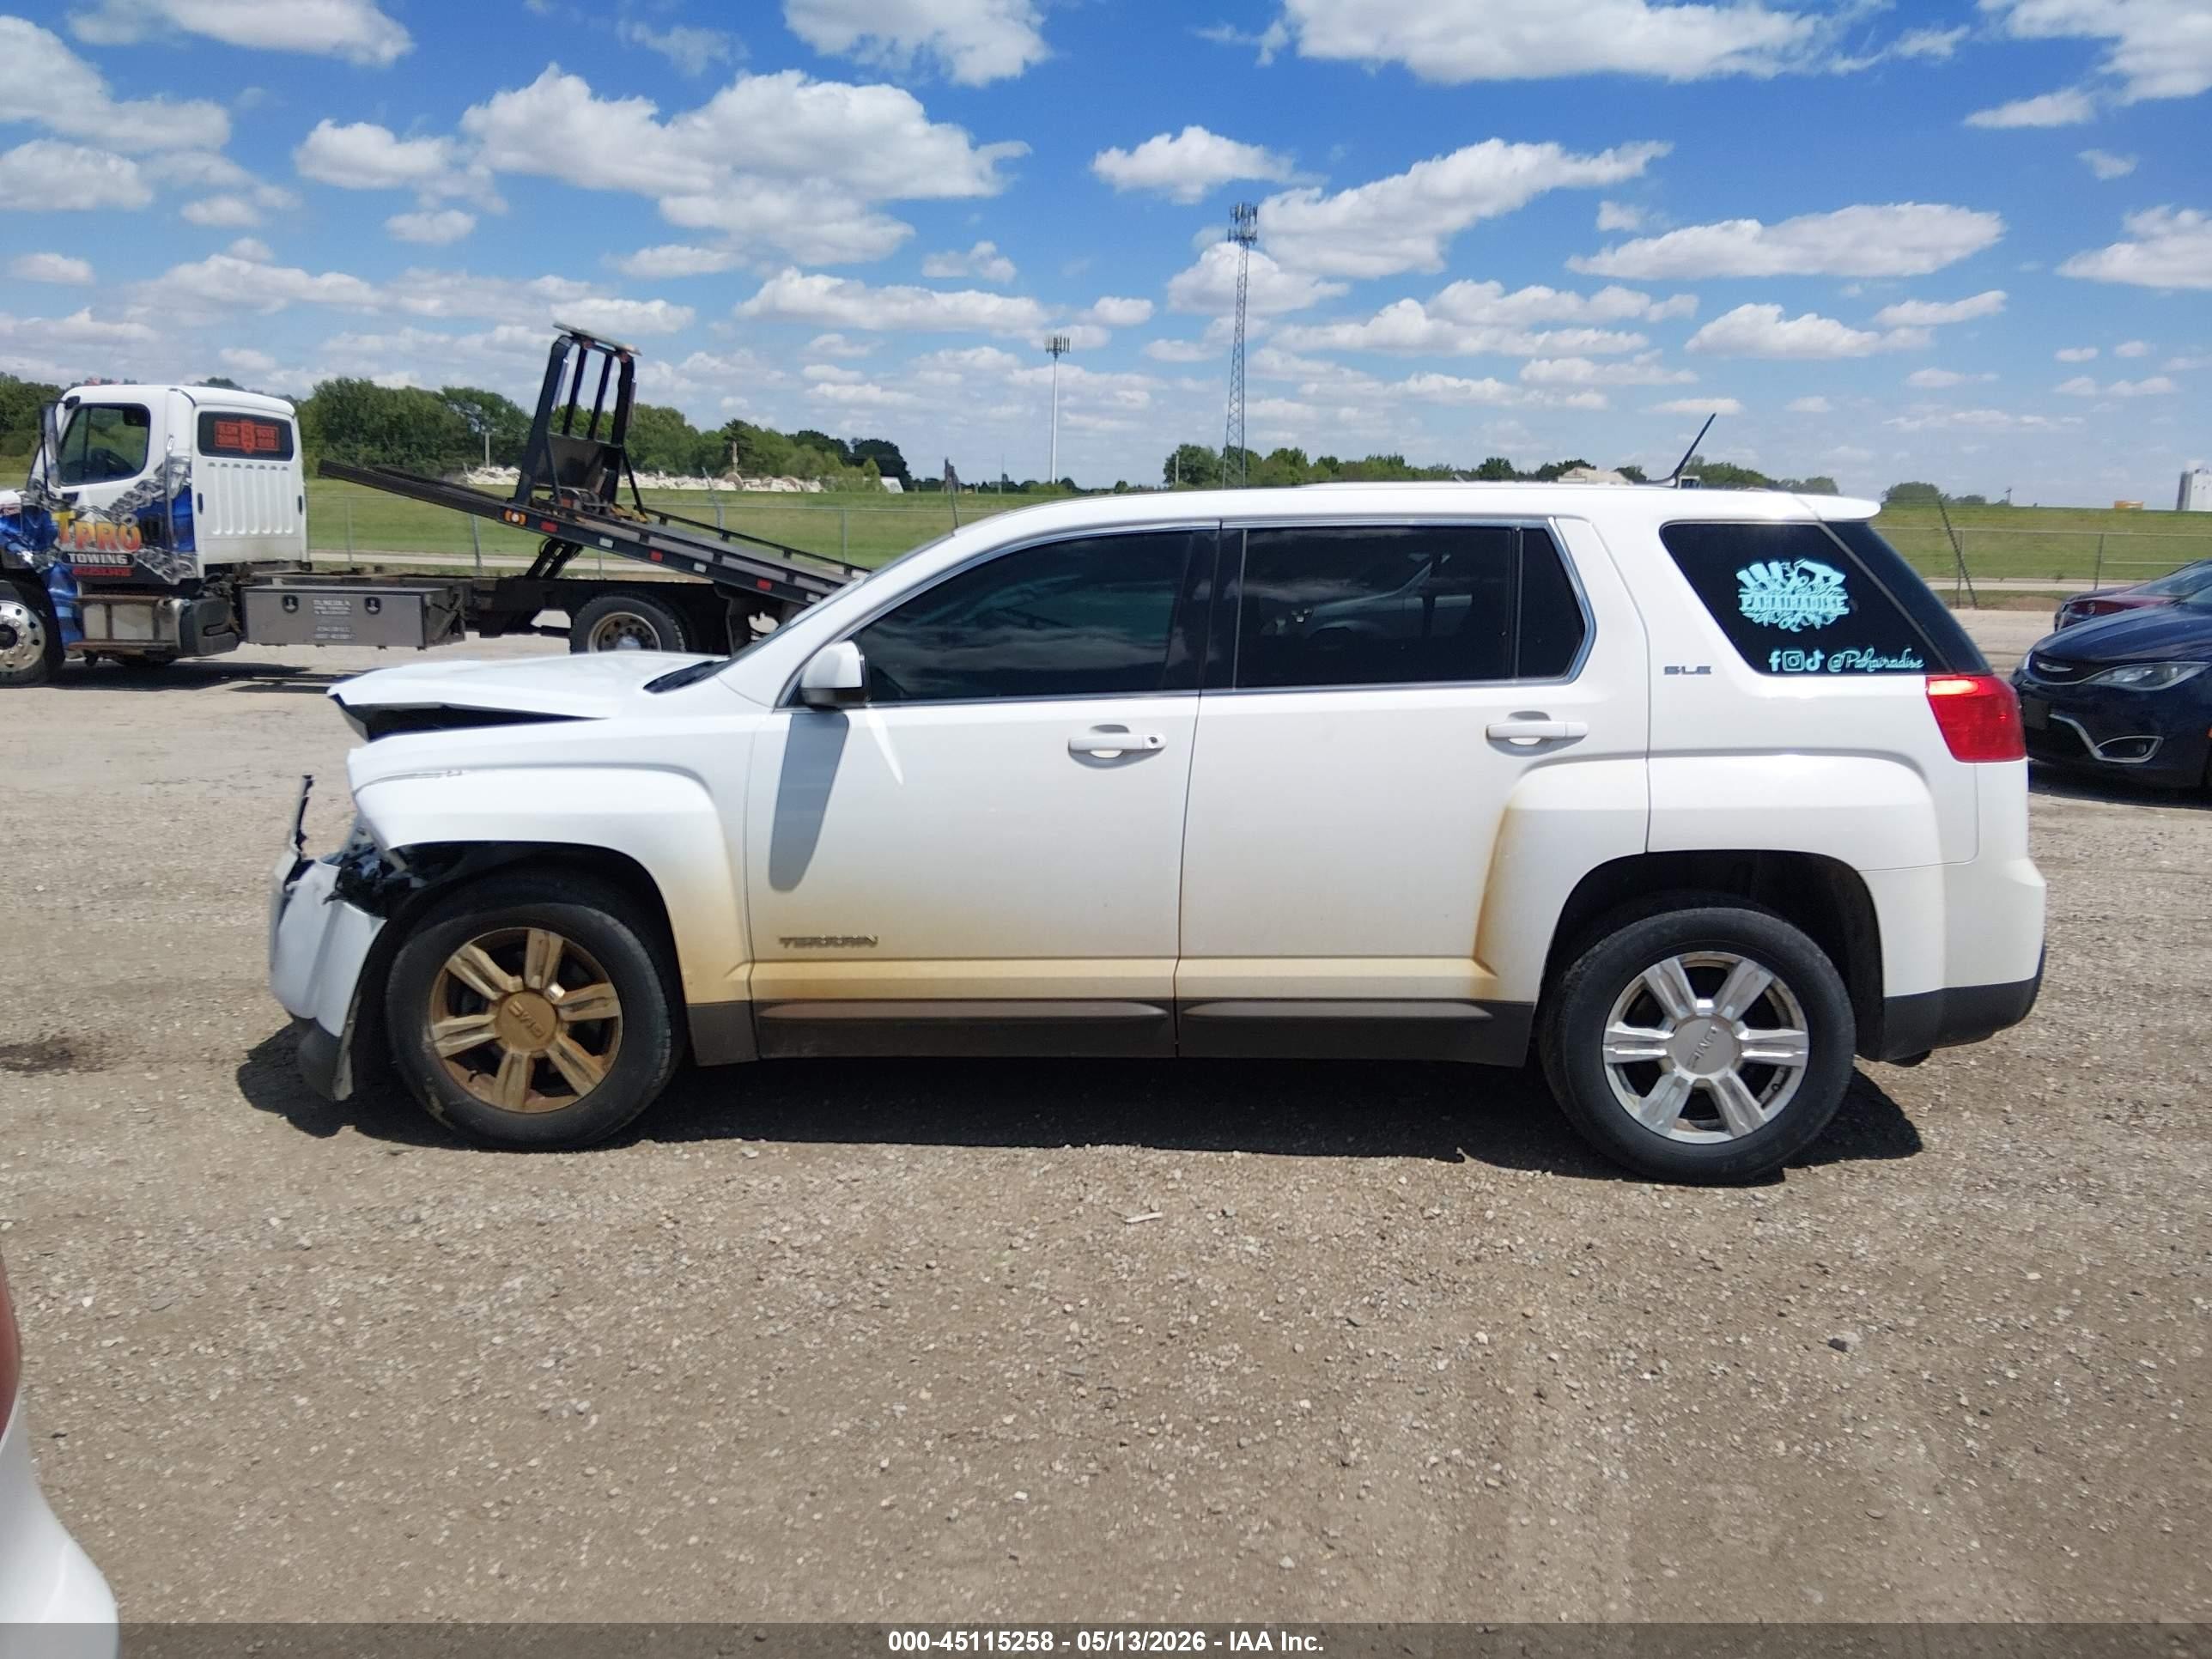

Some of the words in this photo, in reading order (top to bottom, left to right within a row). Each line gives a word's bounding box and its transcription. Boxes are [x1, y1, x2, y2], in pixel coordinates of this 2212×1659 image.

[68, 553, 128, 564] TOWING
[1664, 665, 1711, 675] SLE
[779, 934, 879, 948] TERRAIN
